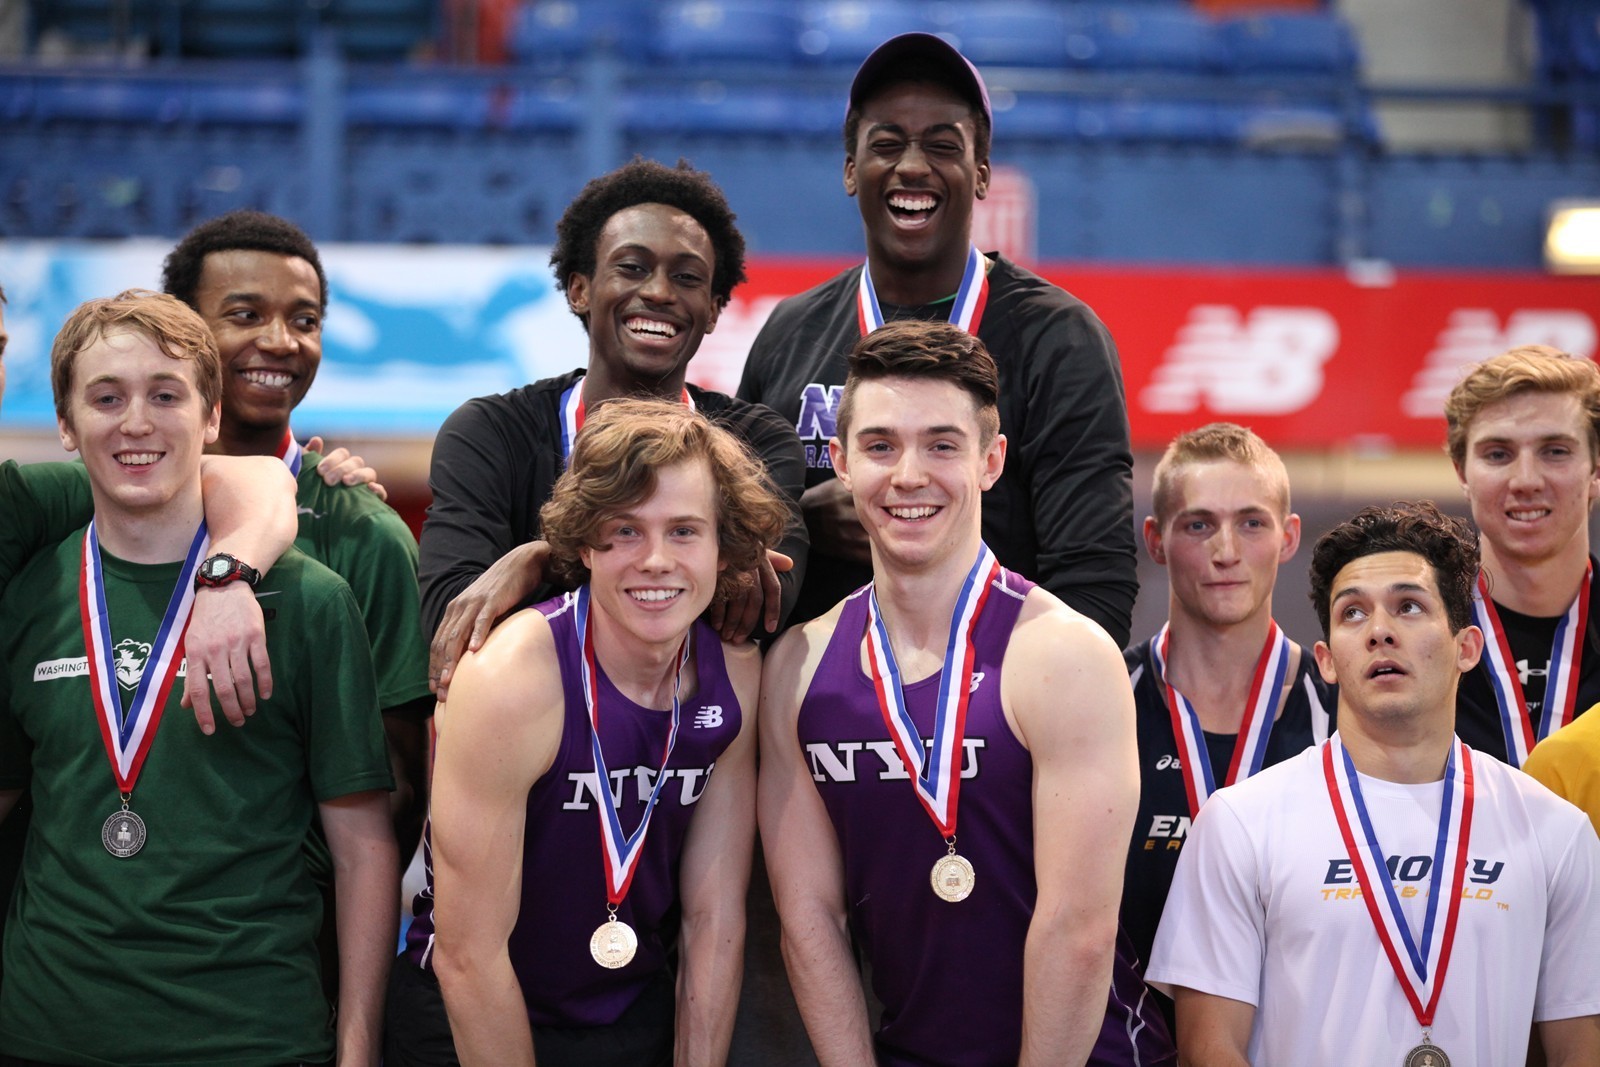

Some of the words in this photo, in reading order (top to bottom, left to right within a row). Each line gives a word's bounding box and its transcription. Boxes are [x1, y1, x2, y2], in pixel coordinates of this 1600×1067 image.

[37, 661, 89, 676] WASHINGT
[563, 762, 716, 810] NYU
[1323, 855, 1505, 884] EOY
[1320, 885, 1398, 900] TRA
